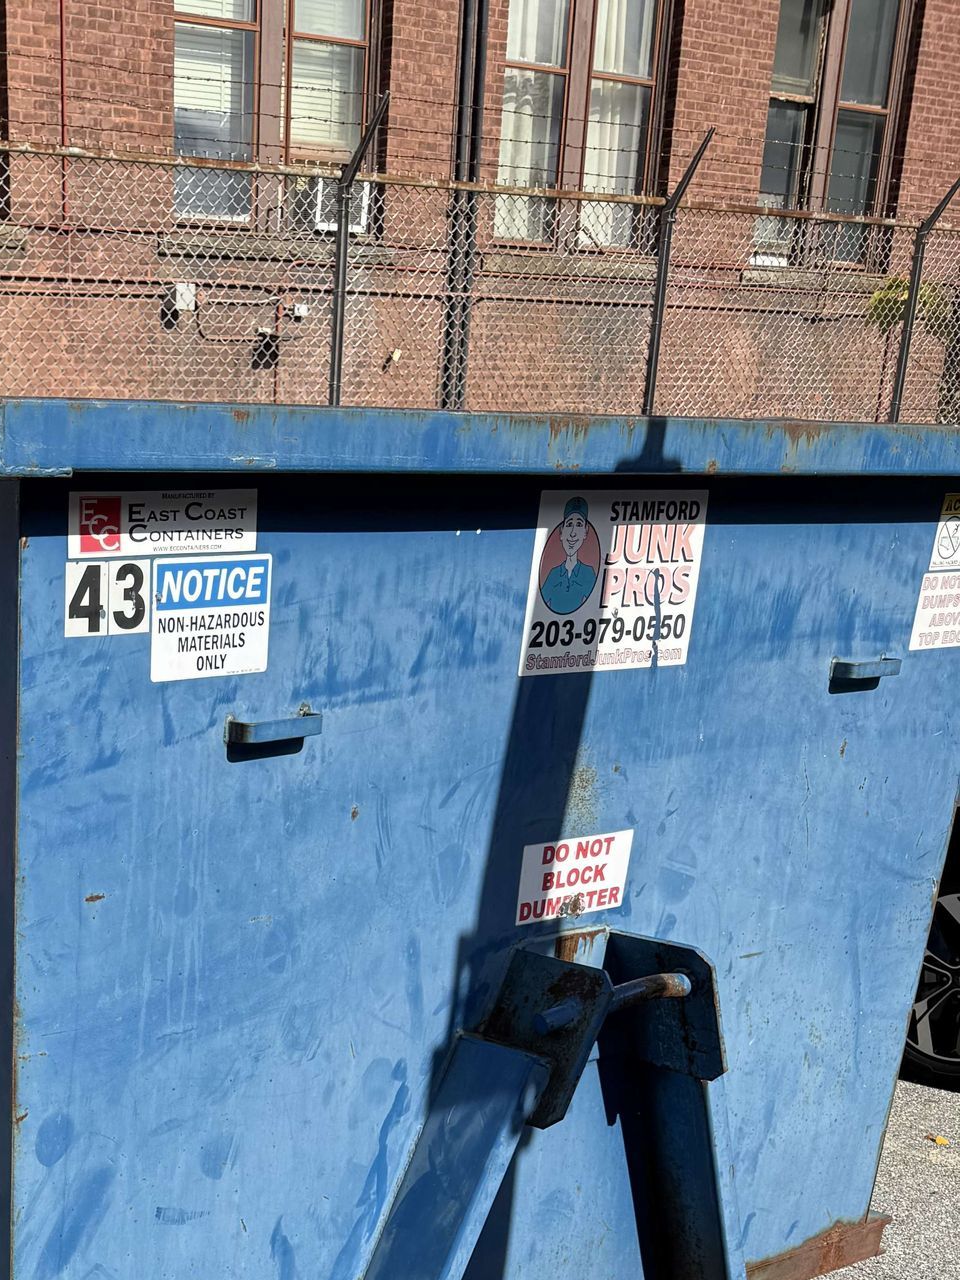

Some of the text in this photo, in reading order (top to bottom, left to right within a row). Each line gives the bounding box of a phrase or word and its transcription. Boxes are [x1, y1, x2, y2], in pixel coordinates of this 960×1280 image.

[610, 500, 700, 522] STAMFORD
[128, 524, 244, 543] CONTAINERS
[604, 524, 696, 565] JUNK
[160, 566, 265, 604] NOTICE
[598, 565, 692, 608] PROS
[922, 576, 939, 590] DO
[68, 563, 146, 633] 43
[158, 610, 265, 634] NON-HAZARDOUS
[528, 614, 686, 648] 203-979-0550
[177, 632, 246, 653] MATERIALS
[919, 631, 940, 646] TOP
[196, 654, 228, 672] ONLY
[526, 648, 682, 670] StamfordJunkProscom
[542, 837, 615, 865] DO NOT
[542, 864, 608, 891] BLOCK
